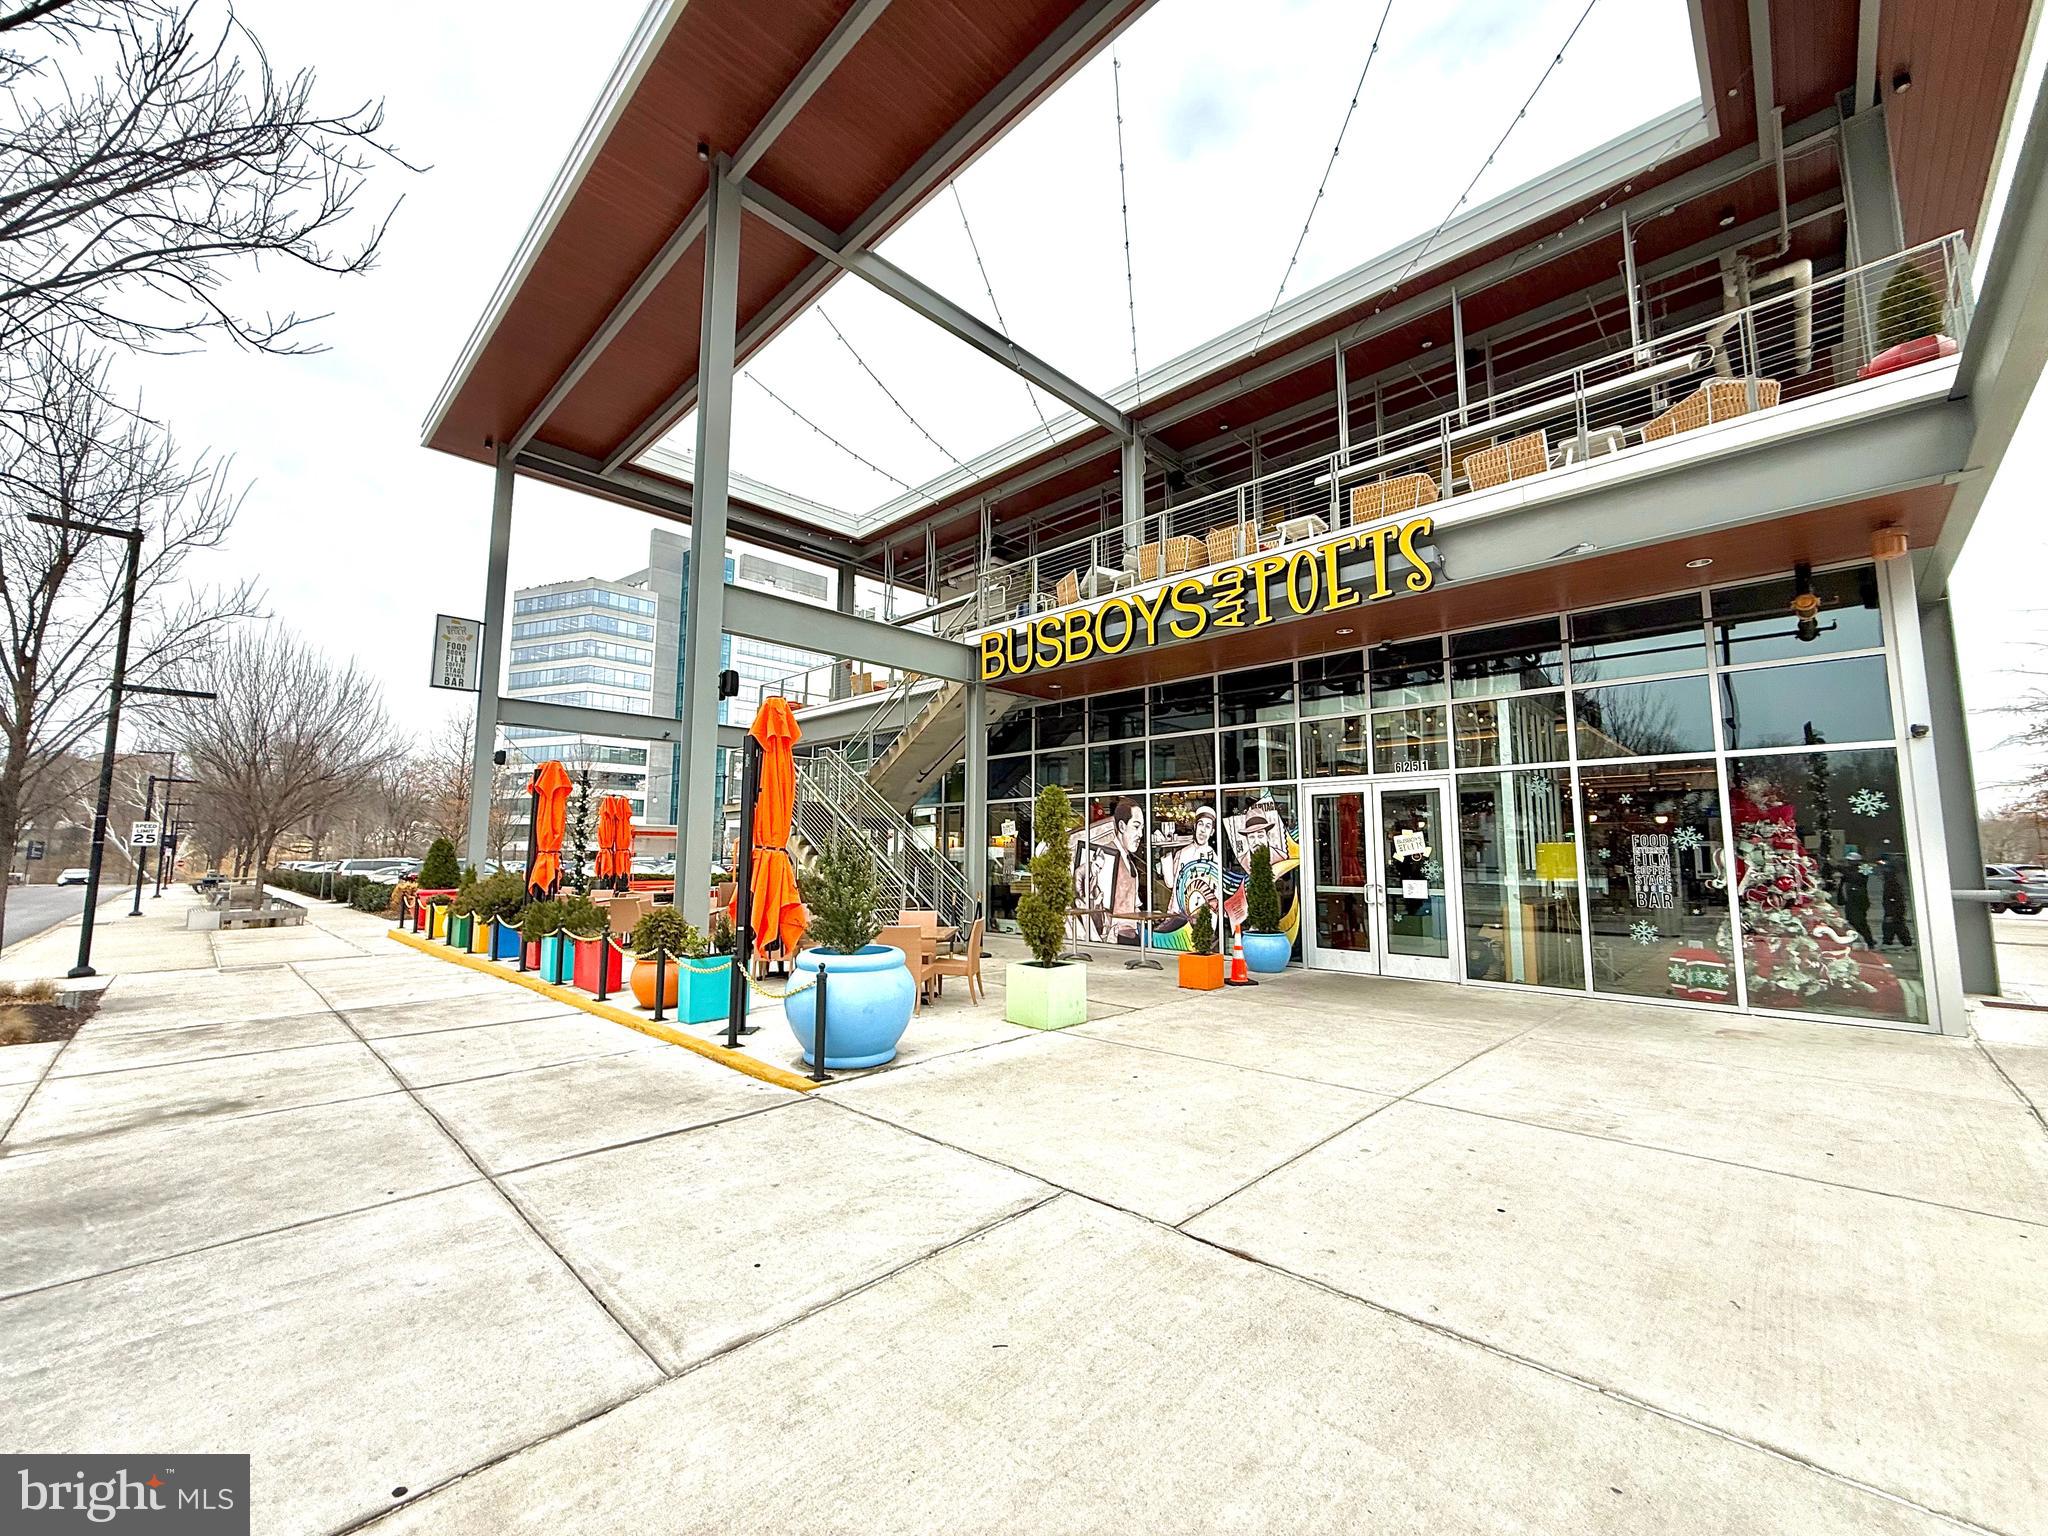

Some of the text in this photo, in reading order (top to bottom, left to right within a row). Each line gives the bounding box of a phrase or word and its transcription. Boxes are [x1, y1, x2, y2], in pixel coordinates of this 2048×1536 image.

[981, 516, 1436, 681] BUSBOYS AND POETS
[446, 642, 467, 651] FOOD
[445, 655, 466, 663] FILM
[445, 667, 465, 675] STAGE
[444, 676, 465, 687] BAR
[1395, 760, 1427, 773] 6251
[133, 834, 156, 843] 25
[1632, 834, 1668, 847] FOOD
[1633, 853, 1670, 866] FILM
[1634, 865, 1671, 875] COFFEE
[1635, 874, 1671, 886] STAGE
[1636, 891, 1674, 908] BAR
